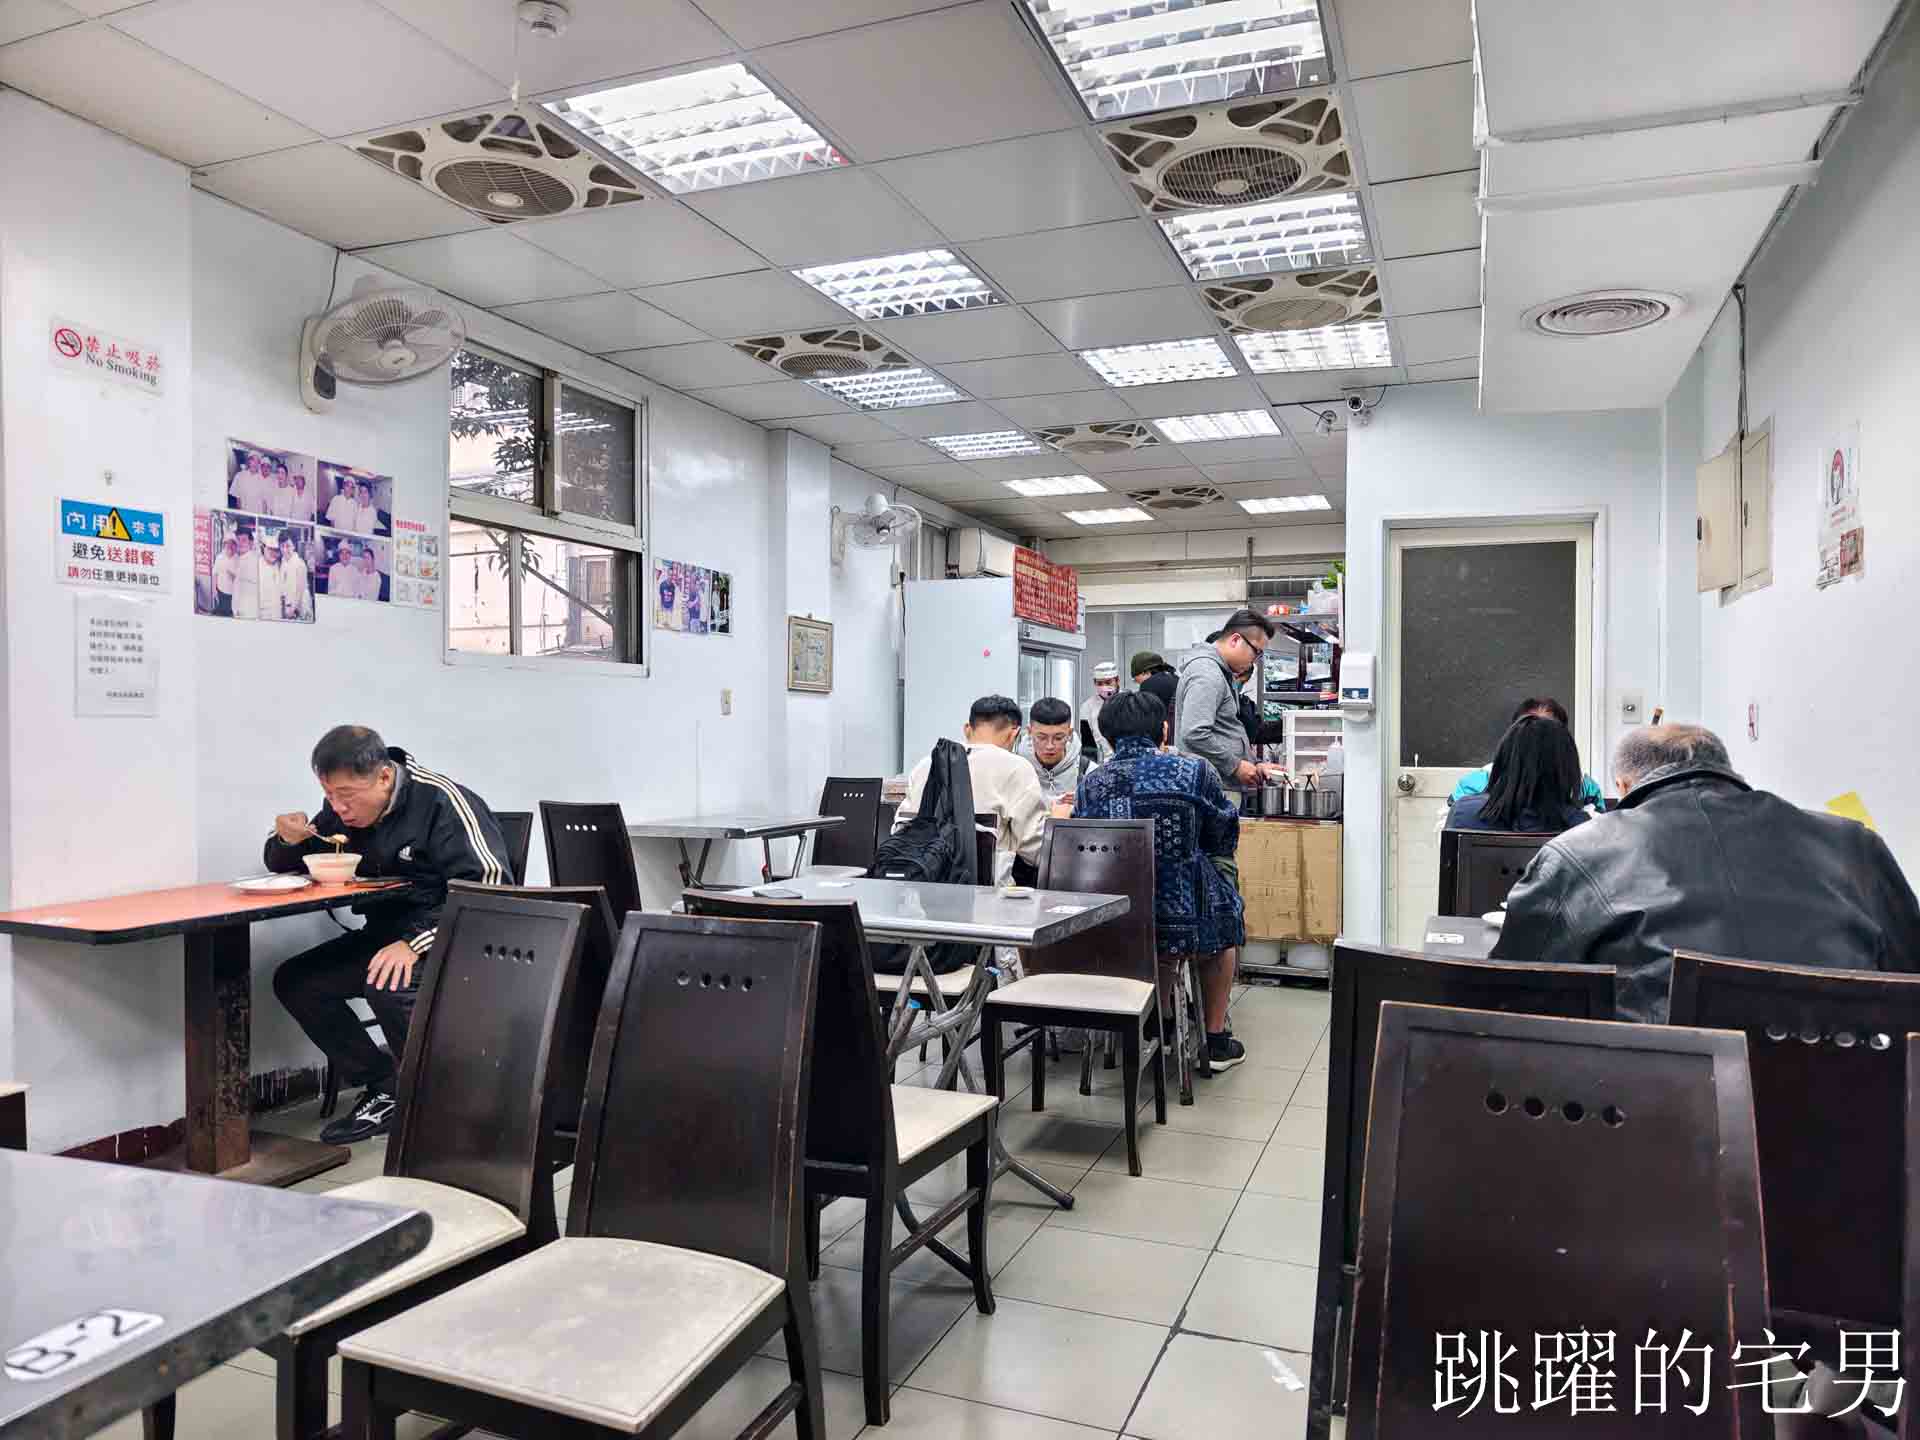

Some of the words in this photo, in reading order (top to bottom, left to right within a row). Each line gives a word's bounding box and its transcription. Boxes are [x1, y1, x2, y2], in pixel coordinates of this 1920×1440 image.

[85, 351, 104, 367] No
[106, 359, 157, 385] Smoking
[72, 542, 155, 566] 避免送錯餐
